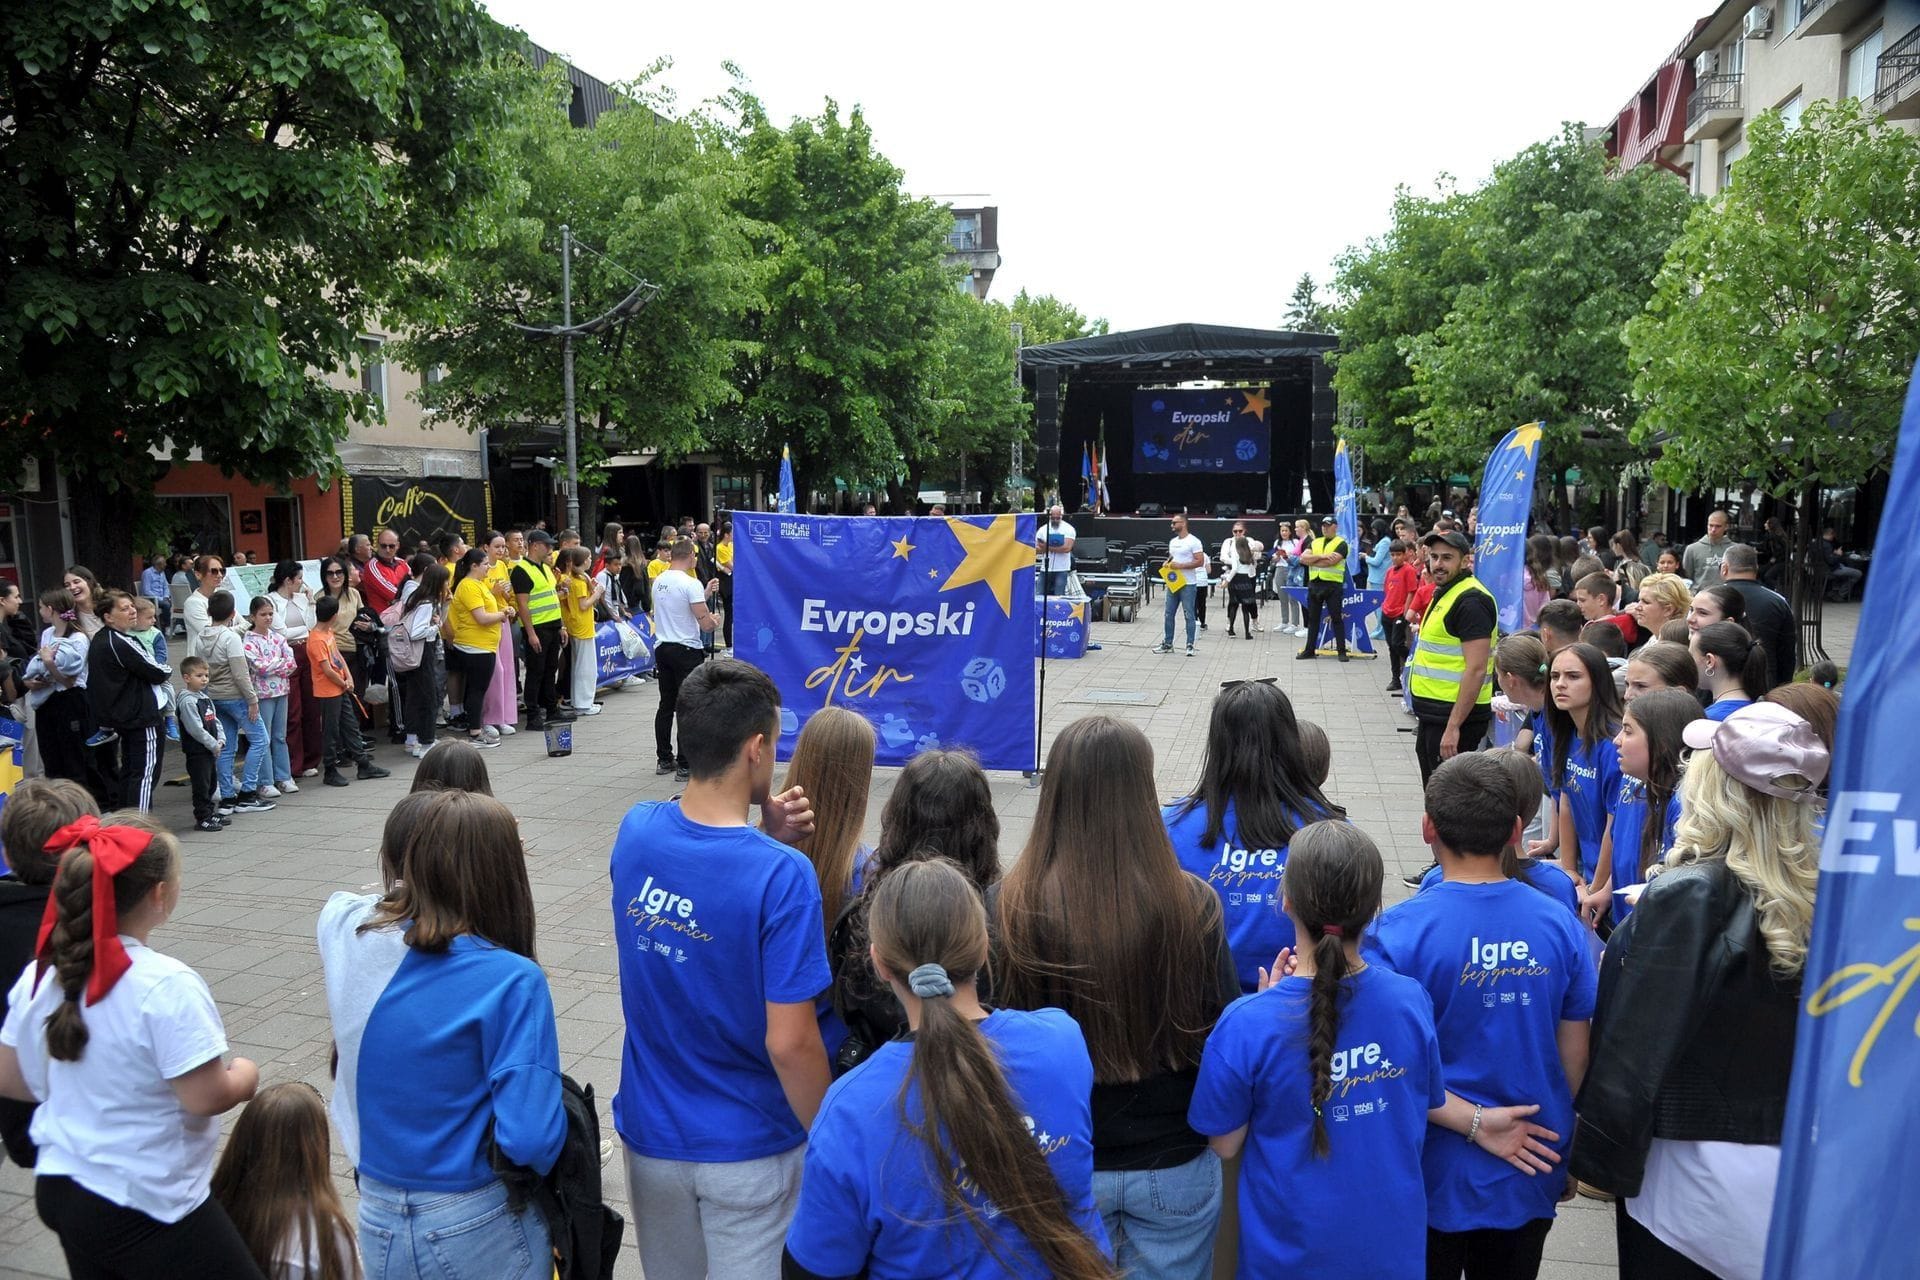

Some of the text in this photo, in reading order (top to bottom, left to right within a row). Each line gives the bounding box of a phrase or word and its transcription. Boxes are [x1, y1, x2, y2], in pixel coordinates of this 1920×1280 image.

[1172, 411, 1231, 426] Evropski
[377, 485, 426, 525] Caffe
[1475, 522, 1525, 537] Evropski
[800, 598, 976, 644] Evropski
[1220, 842, 1278, 873] Igre
[638, 875, 693, 918] Igre
[1471, 937, 1529, 971] Igre
[1330, 1042, 1381, 1082] gre
